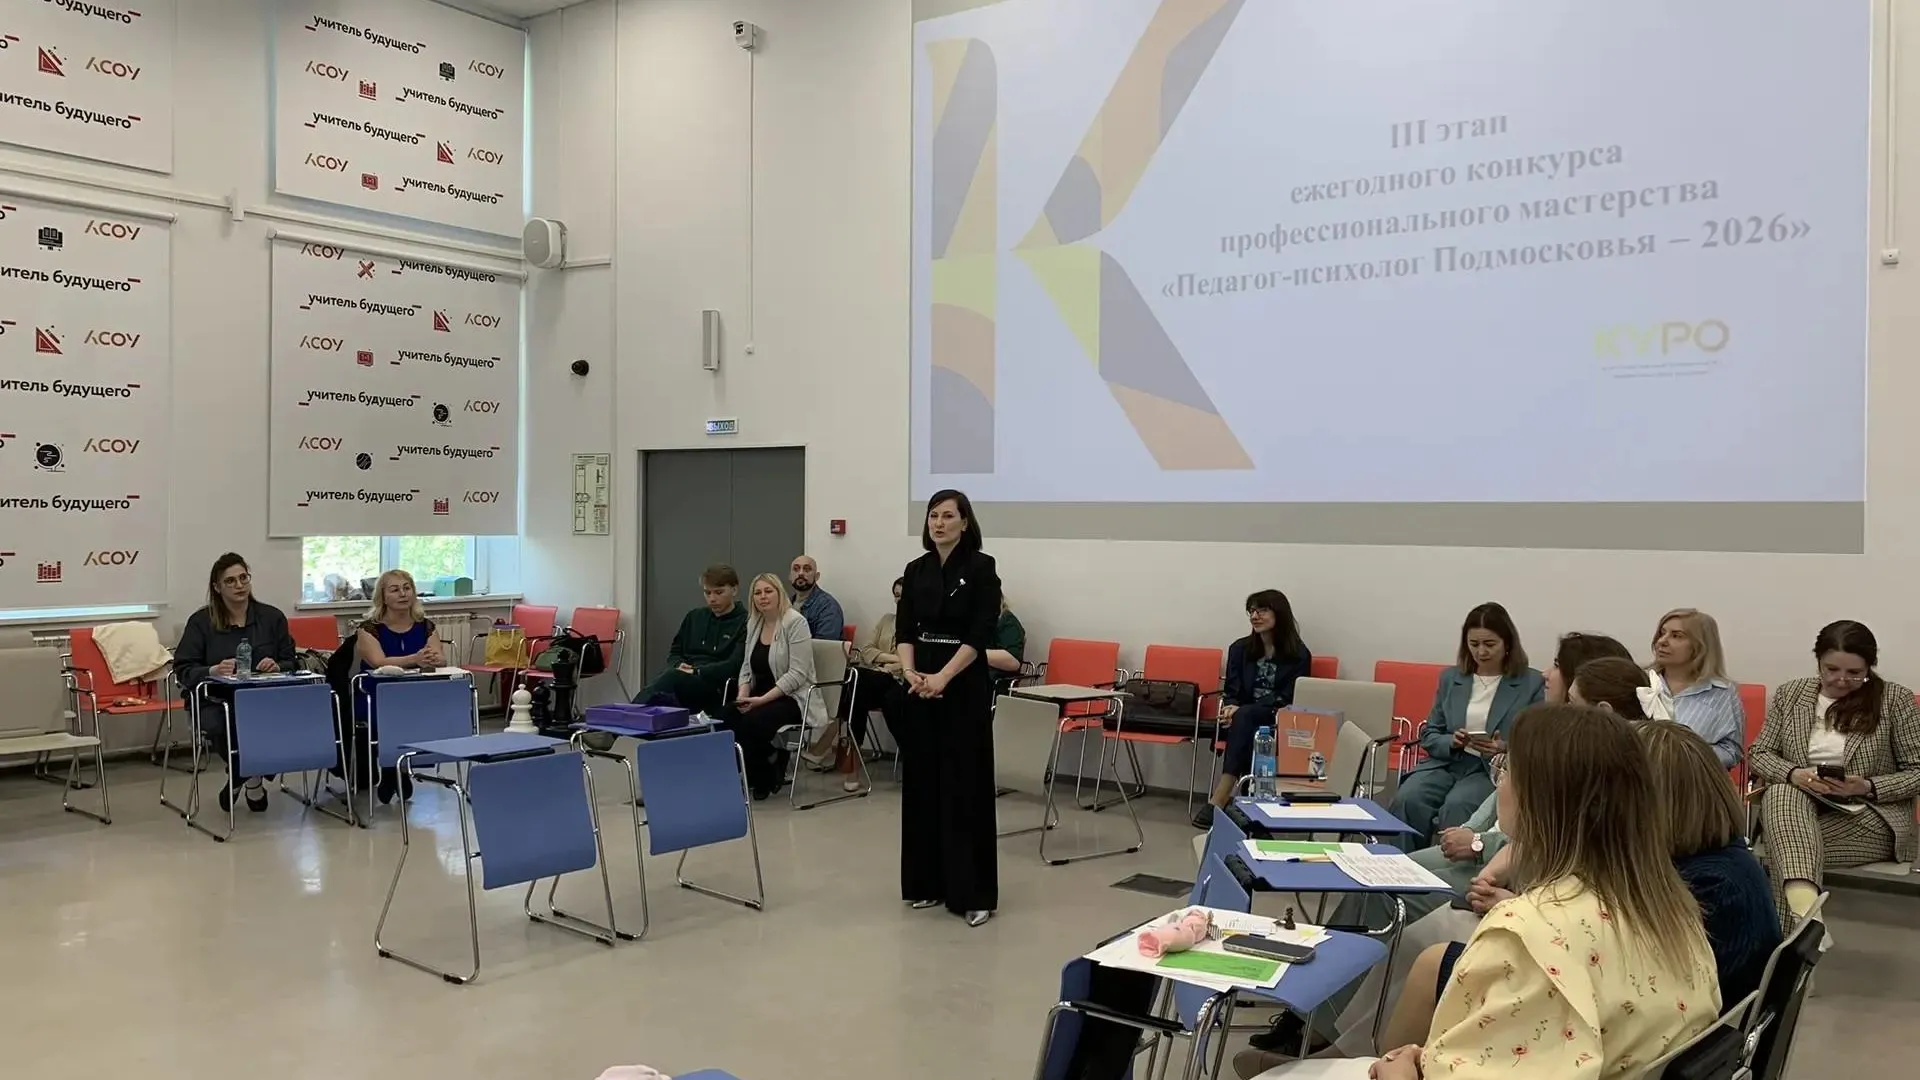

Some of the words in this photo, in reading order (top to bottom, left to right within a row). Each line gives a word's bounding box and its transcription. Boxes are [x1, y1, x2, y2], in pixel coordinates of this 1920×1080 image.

[313, 15, 362, 38] учитель
[364, 28, 420, 54] будущего
[0, 91, 52, 112] итель
[55, 101, 132, 129] будущего
[403, 86, 447, 106] учитель
[448, 97, 498, 120] будущего
[312, 111, 362, 131] учитель
[363, 122, 419, 145] будущего
[1436, 115, 1507, 142] этап
[1290, 166, 1456, 204] ежегодного
[1466, 144, 1623, 181] конкурса
[402, 175, 446, 194] учитель
[447, 183, 498, 205] будущего
[1220, 204, 1510, 257] профессионального
[1519, 179, 1719, 222] мастерства
[399, 259, 444, 275] учитель
[1161, 256, 1425, 299] «Педагог-психолог
[1433, 234, 1656, 273] Подмосковья
[1701, 213, 1812, 249] 2026»
[0, 265, 50, 282] итель
[53, 270, 131, 292] будущего
[308, 293, 358, 309] учитель
[359, 298, 415, 317] будущего
[398, 349, 442, 363] учитель
[444, 354, 494, 369] будущего
[0, 379, 49, 392] итель
[52, 379, 131, 398] будущего
[307, 388, 357, 402] учитель
[358, 391, 414, 407] будущего
[397, 444, 441, 456] учитель
[443, 445, 494, 459] будущего
[0, 497, 48, 509] итель
[52, 495, 130, 512] будущего
[306, 489, 356, 501] учитель
[357, 488, 413, 502] будущего
